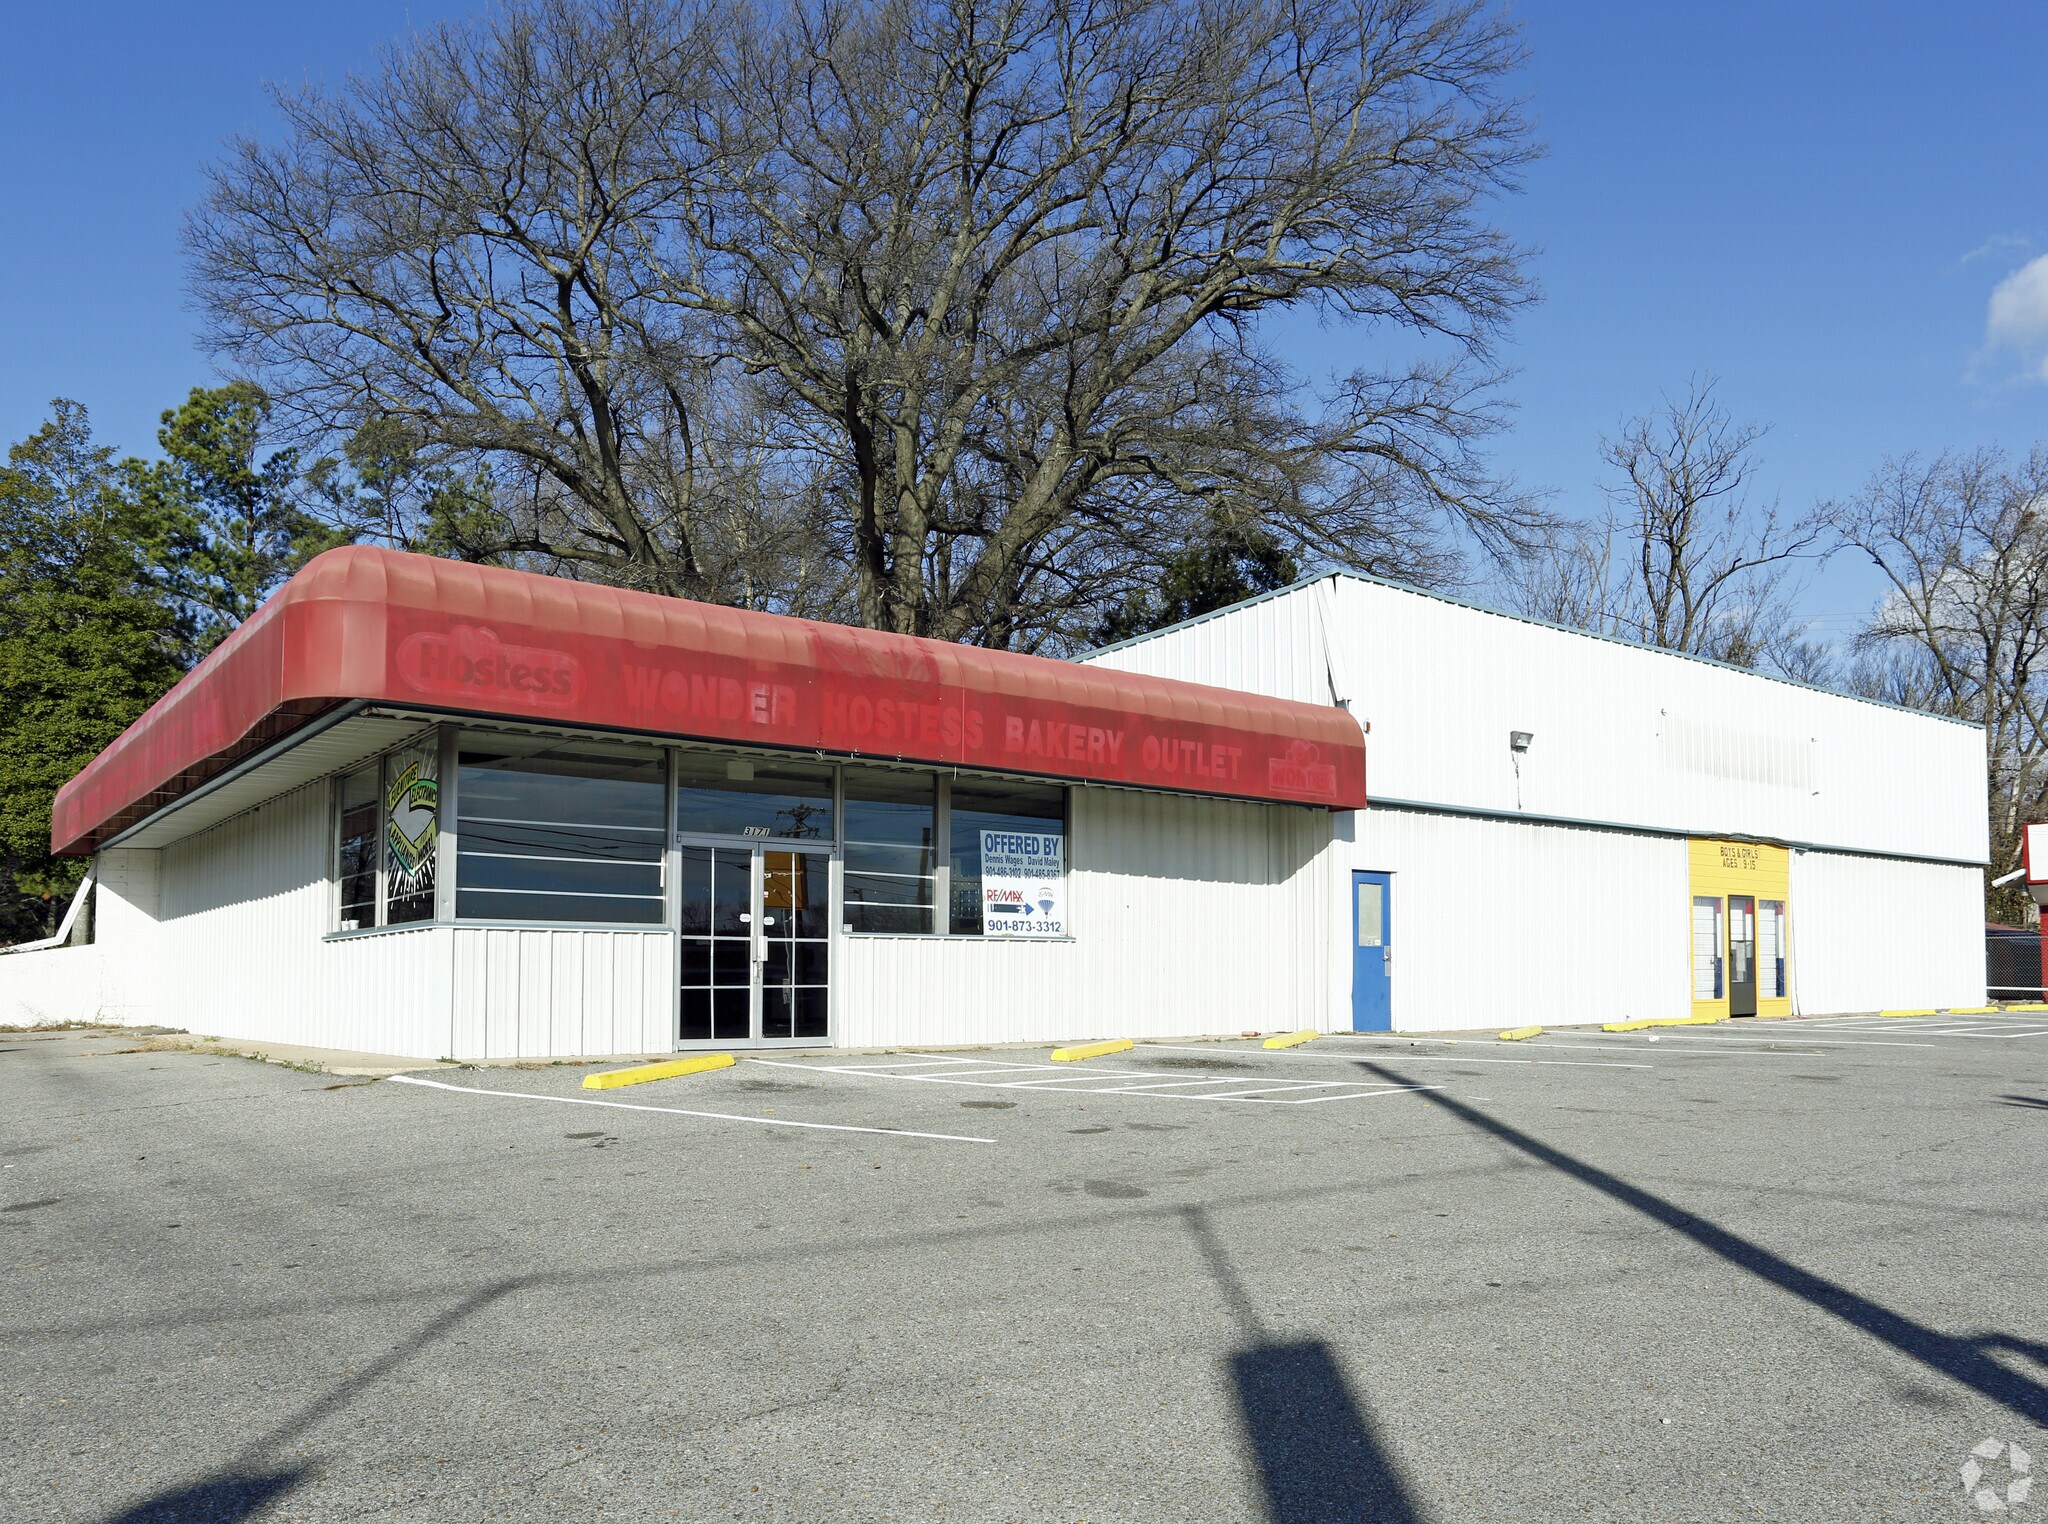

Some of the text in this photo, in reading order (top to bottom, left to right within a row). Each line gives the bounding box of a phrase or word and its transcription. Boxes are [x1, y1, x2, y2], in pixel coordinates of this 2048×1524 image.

[419, 641, 572, 697] Hostess
[622, 663, 1243, 781] WONDER HOSTESS BAKERY OUTLET
[745, 828, 768, 836] 3171
[985, 833, 1060, 856] OFFERED BY
[1720, 846, 1759, 859] BOYS & GIRLS
[985, 853, 1004, 864] Dennis
[1005, 854, 1023, 867] Wages
[1028, 856, 1043, 866] David
[1722, 858, 1756, 870] AGES 9-15
[986, 889, 1024, 902] RE/MAX
[988, 920, 1061, 932] 901-873-3312
